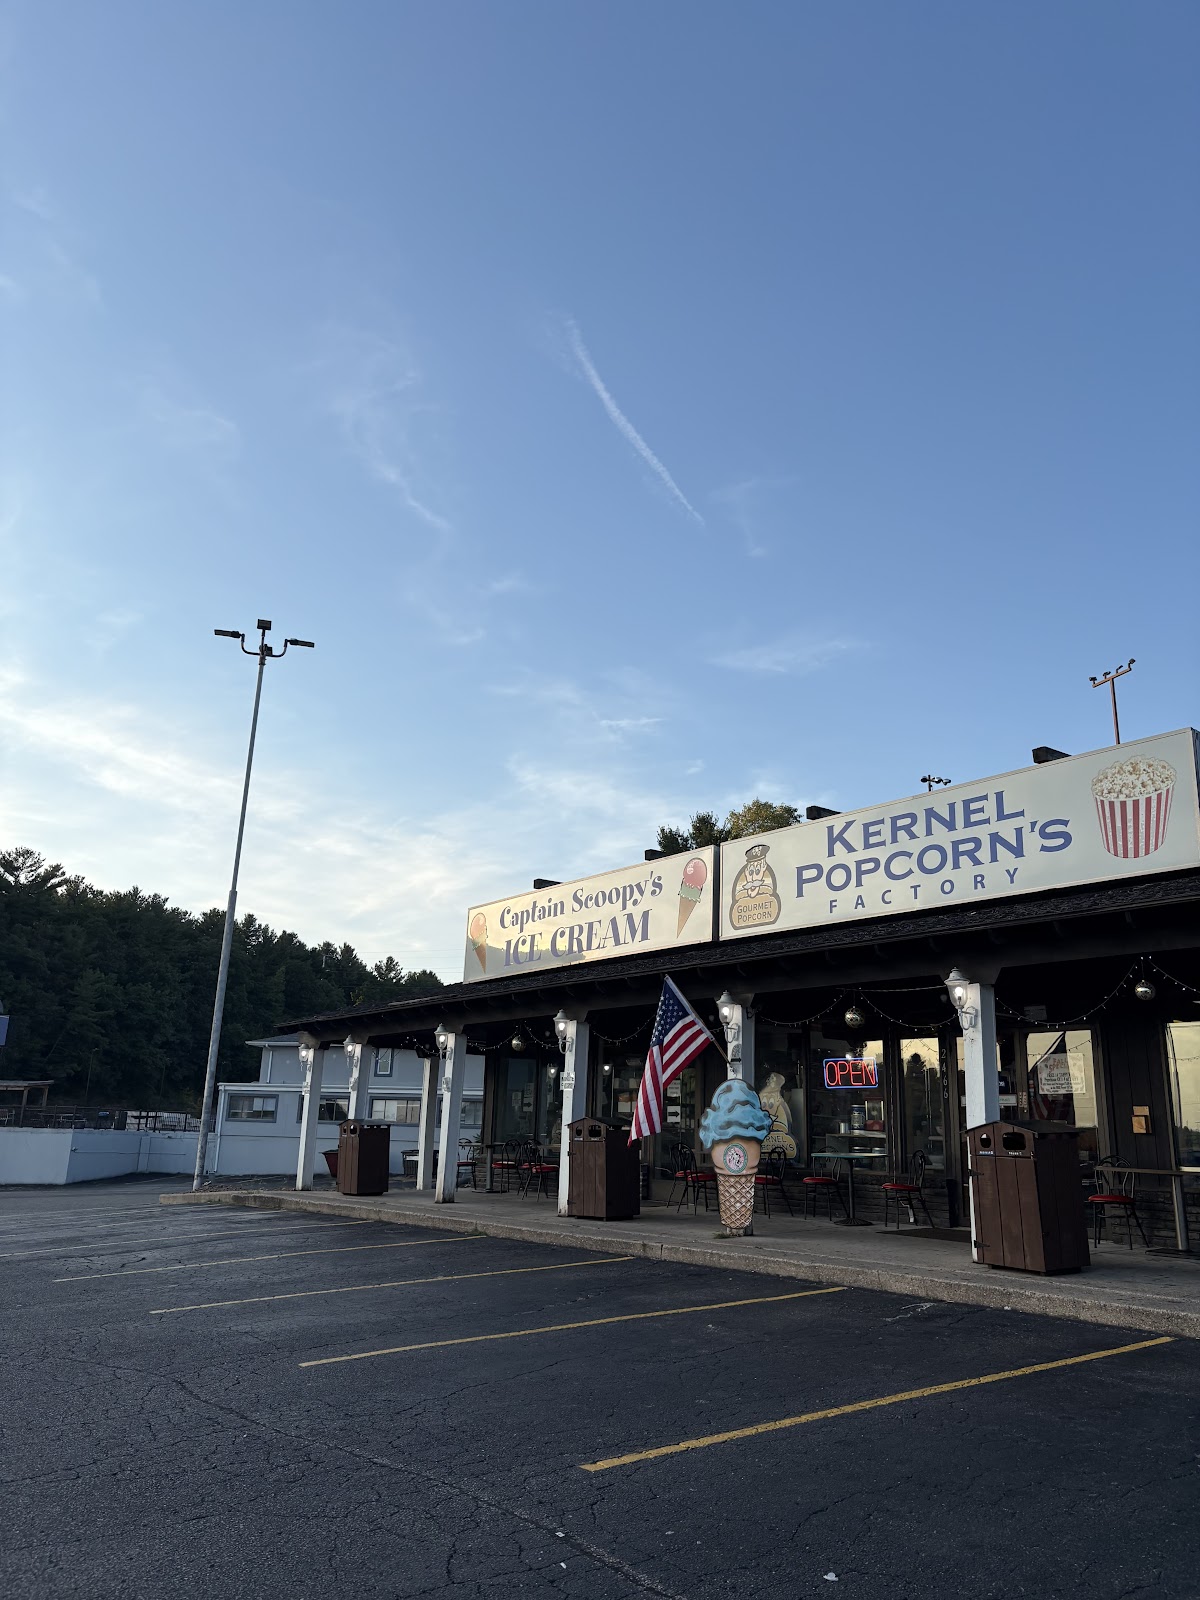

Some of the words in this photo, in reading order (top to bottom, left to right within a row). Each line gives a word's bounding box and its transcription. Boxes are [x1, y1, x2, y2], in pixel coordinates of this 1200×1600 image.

[826, 790, 1025, 858] KERNEL
[795, 818, 1073, 899] POPCORN'S
[500, 898, 565, 934] Captain
[572, 871, 663, 913] Scoopy's
[736, 900, 773, 914] GOURMET
[829, 868, 1019, 914] FACTORY
[503, 932, 542, 967] ICE
[550, 909, 653, 956] CREAM
[737, 910, 772, 924] POPCORN
[825, 1060, 876, 1086] OPEN
[766, 1135, 787, 1143] RNEL
